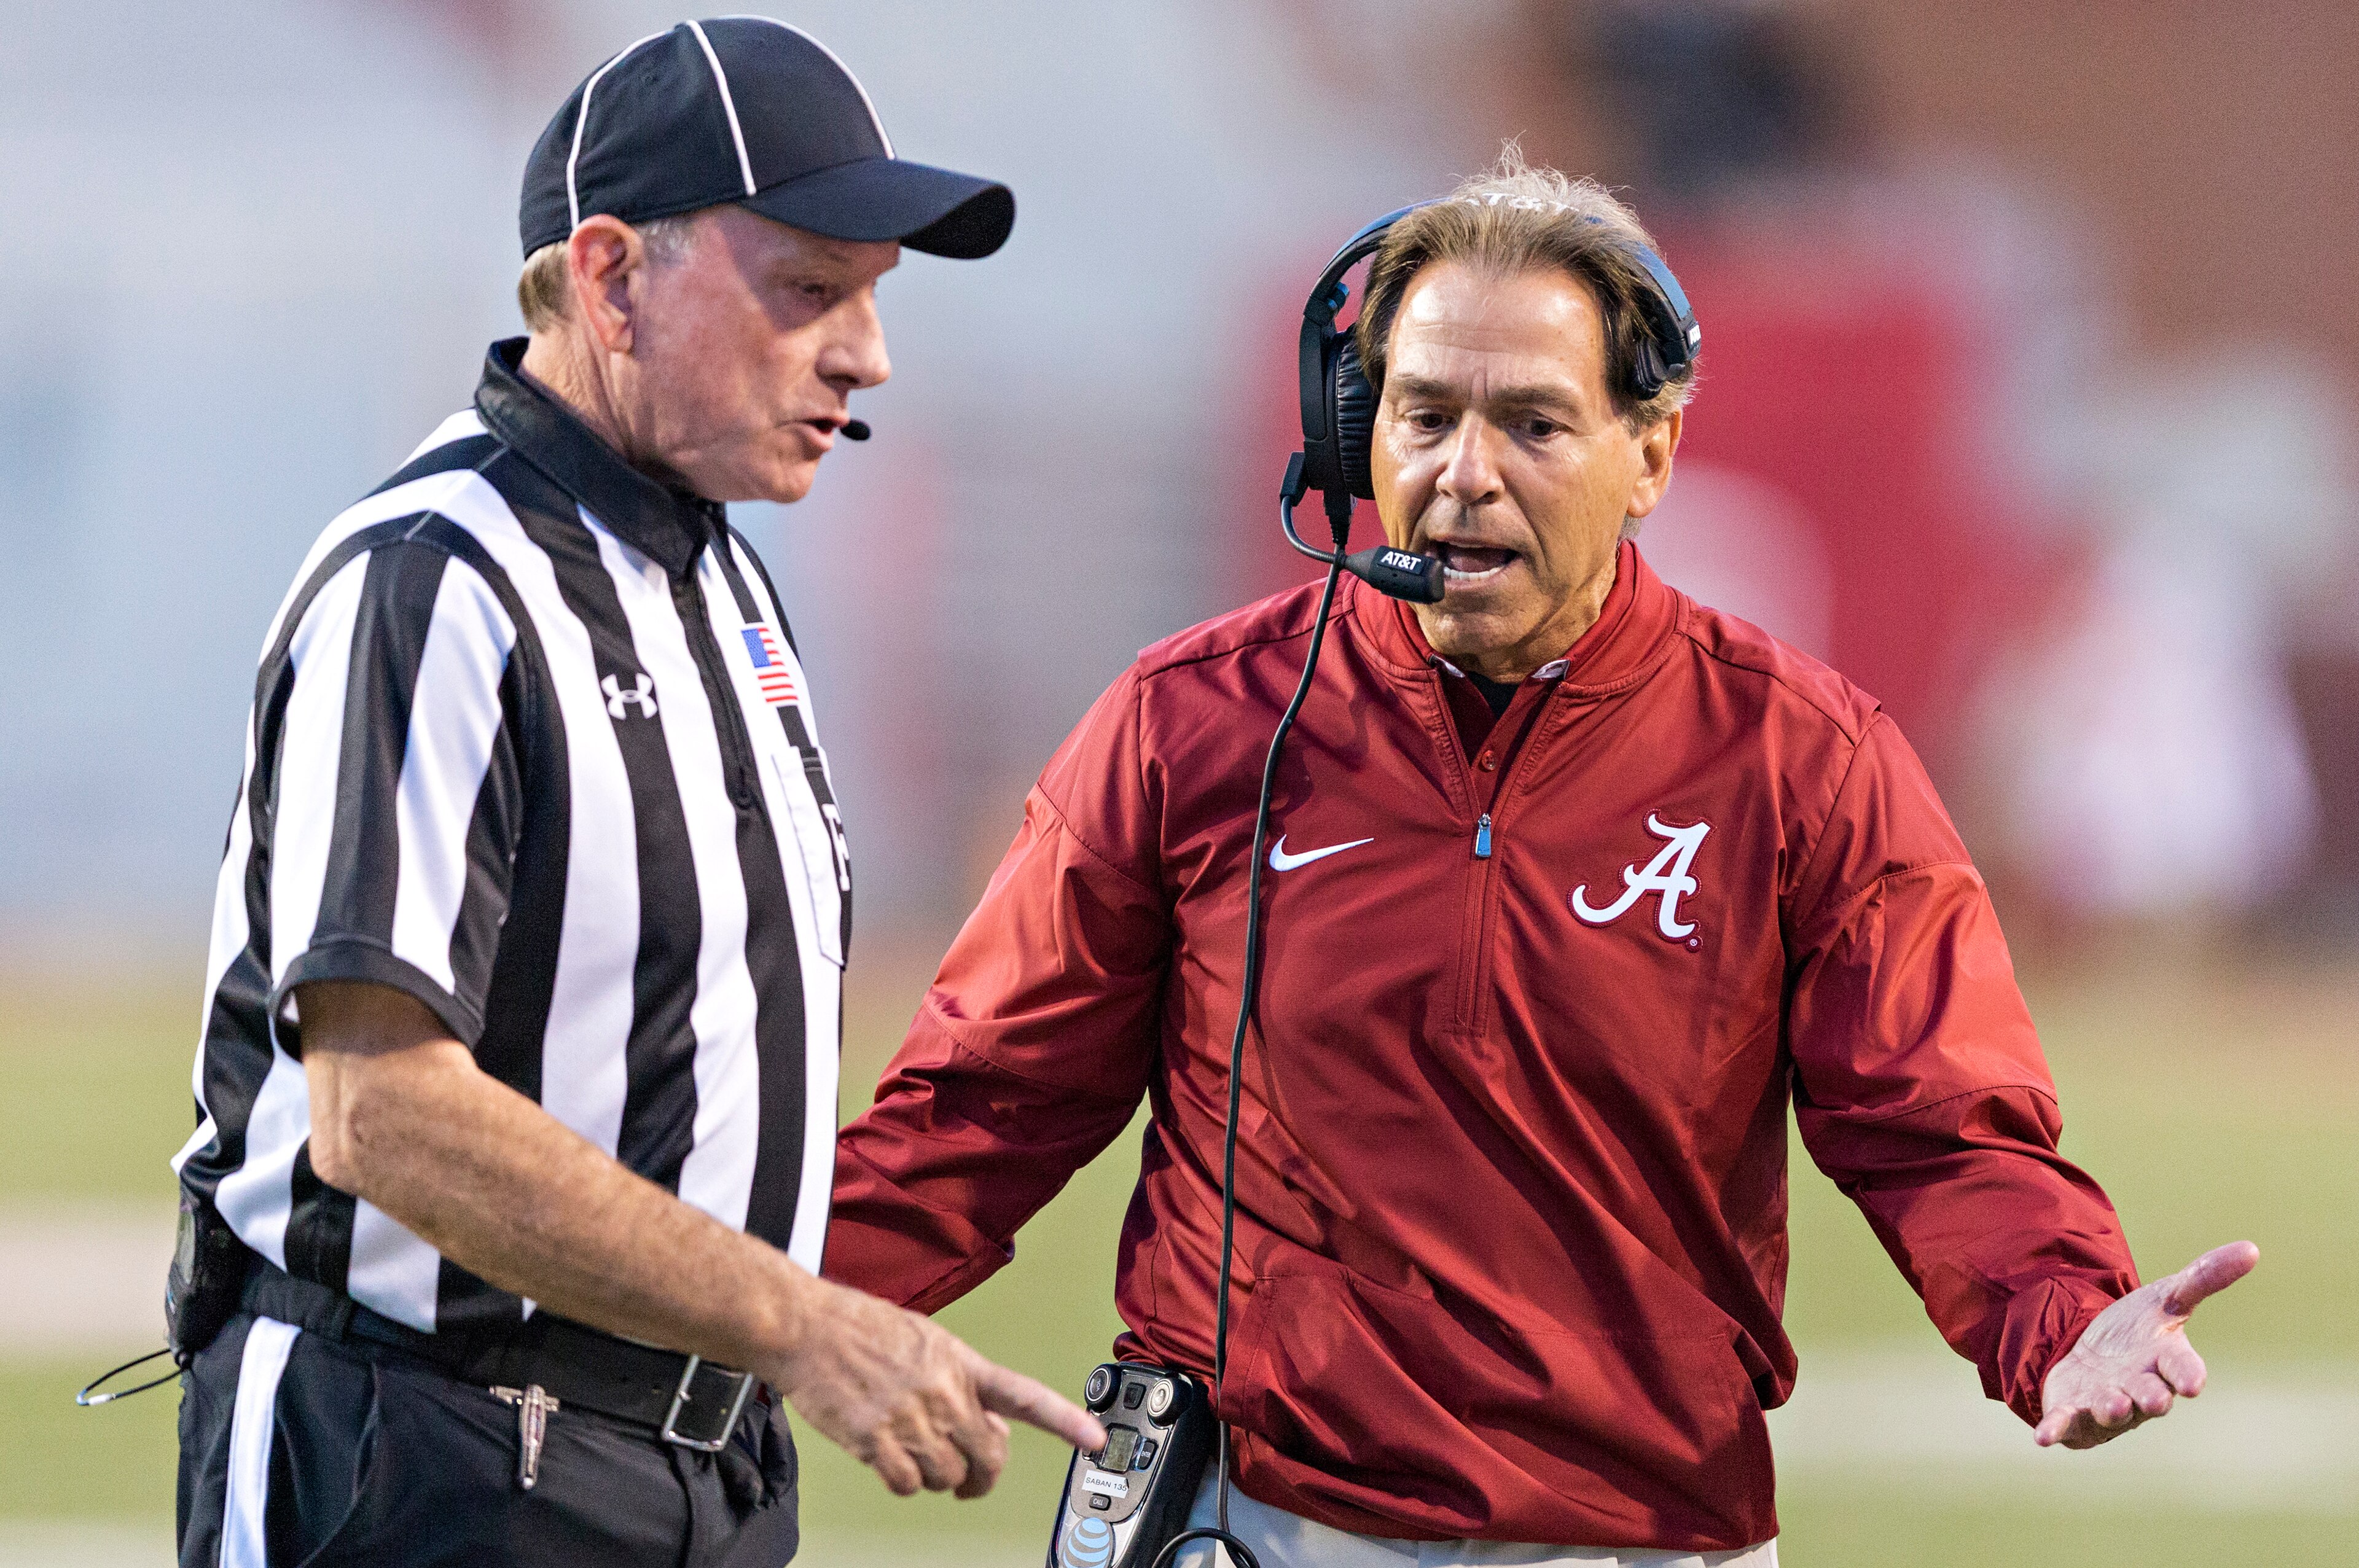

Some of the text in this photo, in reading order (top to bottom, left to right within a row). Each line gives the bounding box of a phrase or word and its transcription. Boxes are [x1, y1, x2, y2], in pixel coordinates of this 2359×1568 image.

[1381, 551, 1422, 571] AT&T
[1572, 814, 1712, 938] A
[1086, 1476, 1112, 1488] SABAN
